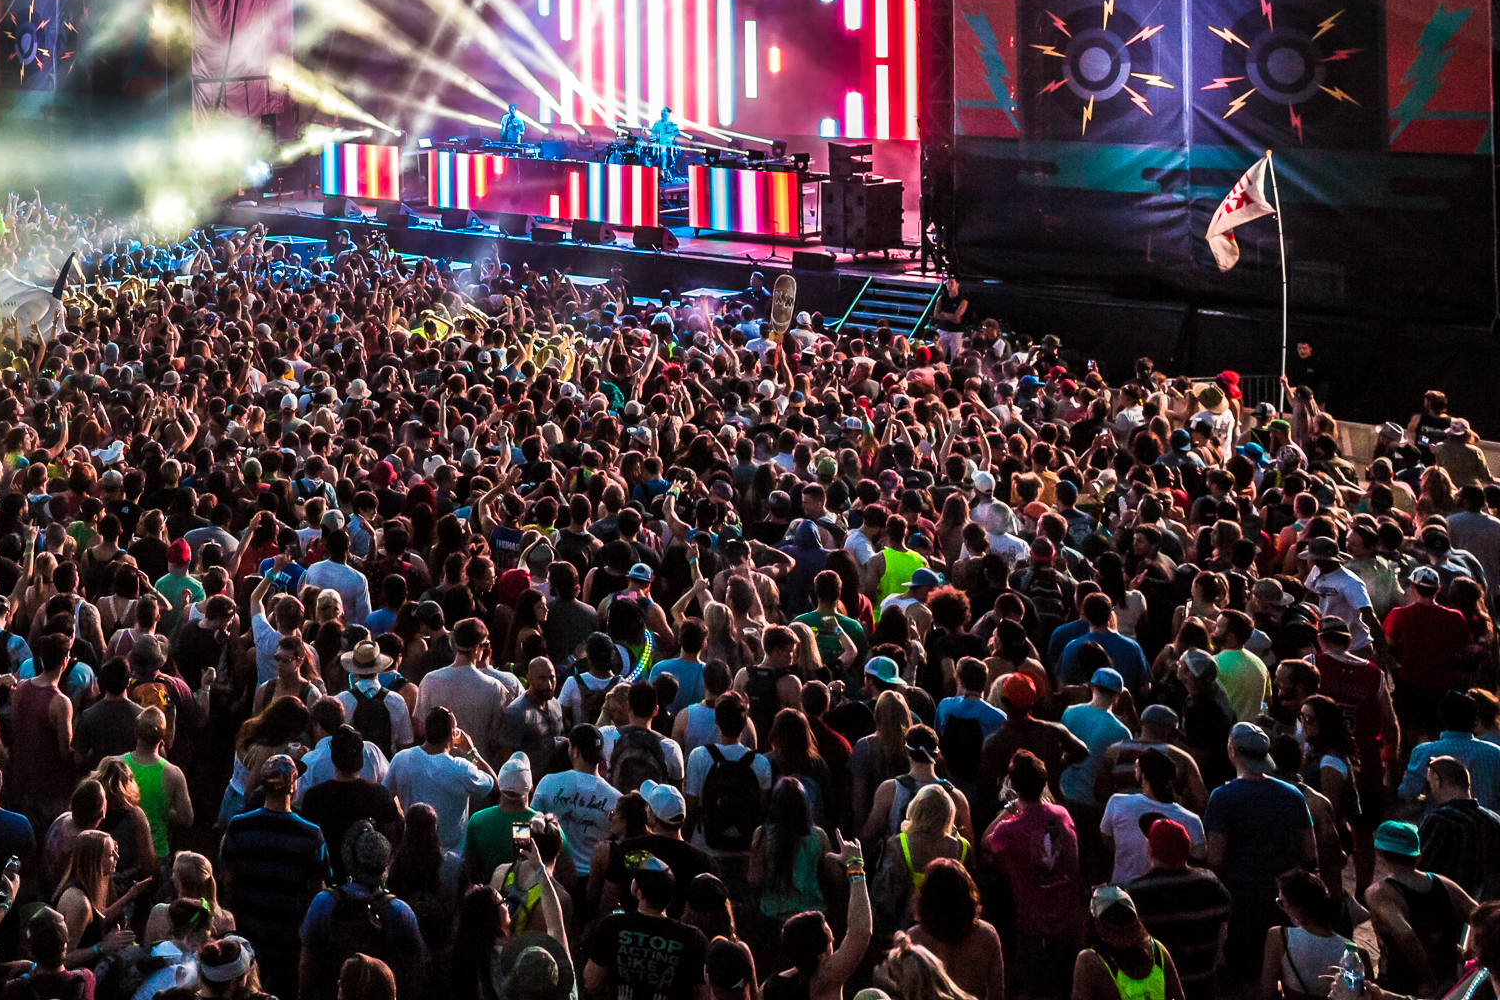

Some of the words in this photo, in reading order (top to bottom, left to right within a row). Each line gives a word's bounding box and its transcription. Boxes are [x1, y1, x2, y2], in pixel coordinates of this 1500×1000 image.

[618, 930, 684, 953] STOP
[617, 954, 658, 972] LIKE
[618, 944, 680, 967] ACTING
